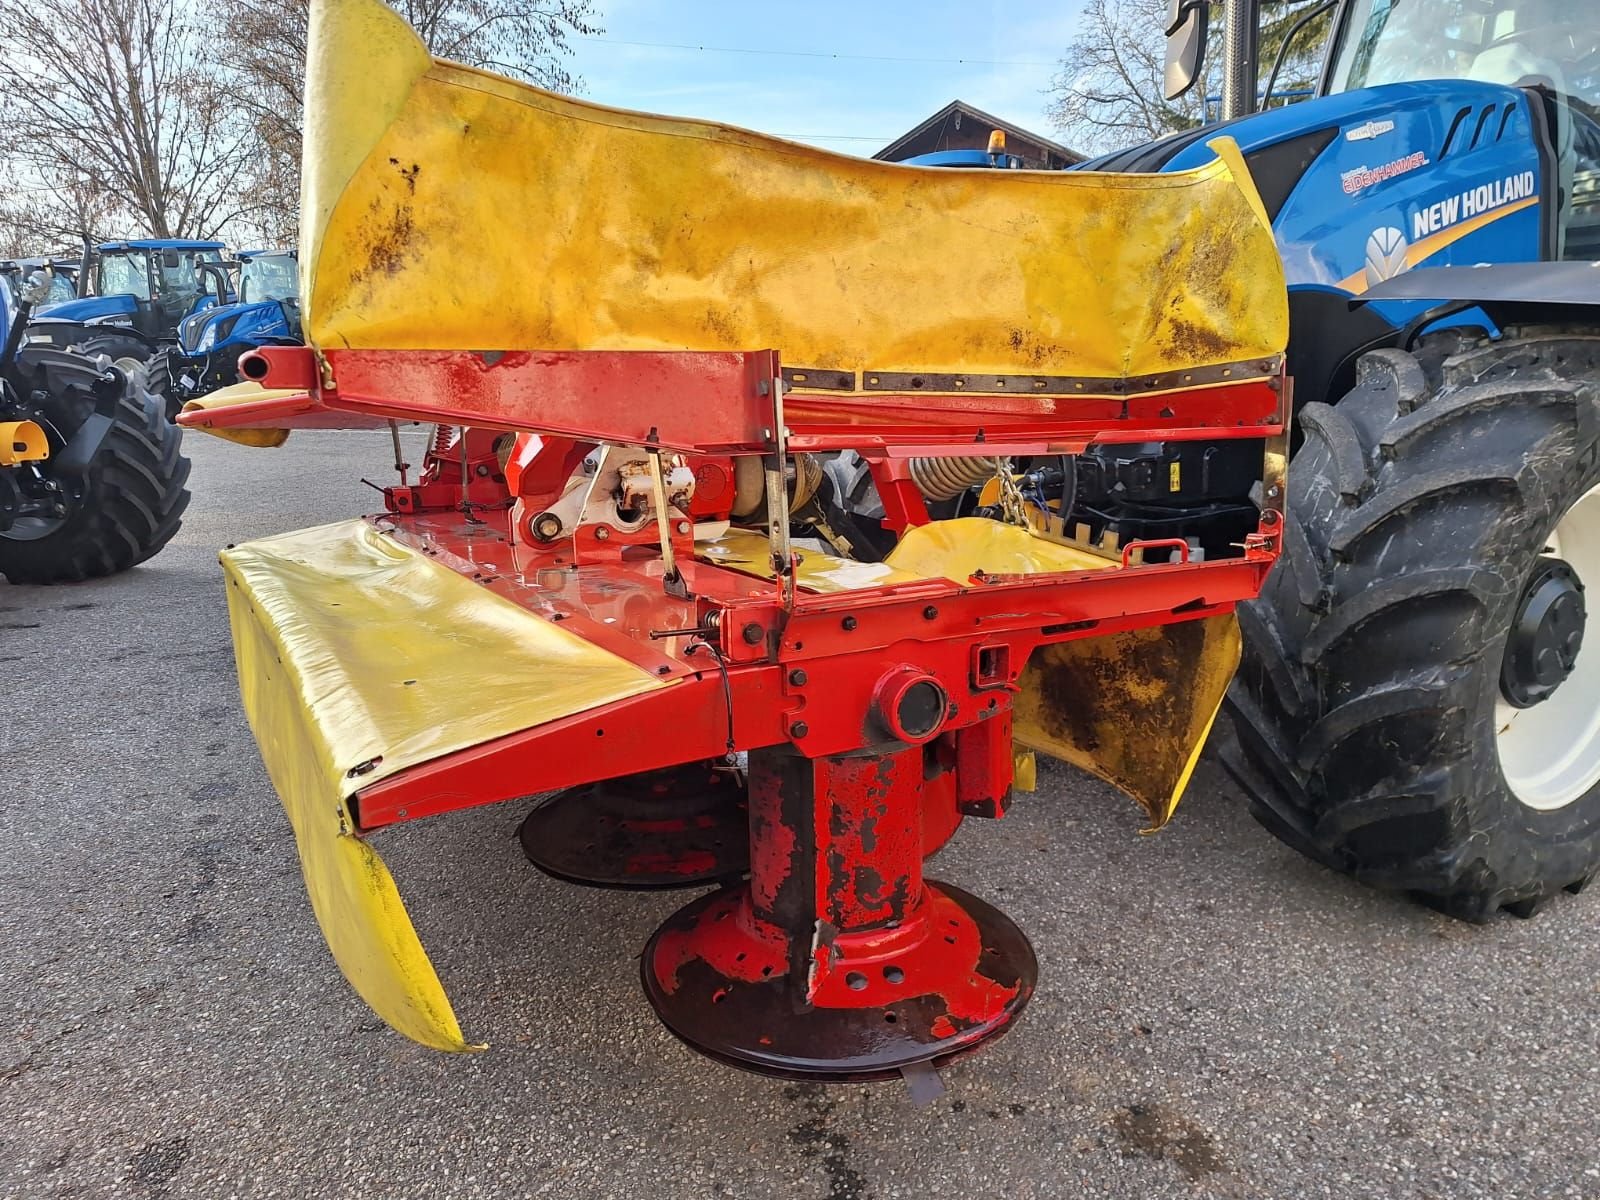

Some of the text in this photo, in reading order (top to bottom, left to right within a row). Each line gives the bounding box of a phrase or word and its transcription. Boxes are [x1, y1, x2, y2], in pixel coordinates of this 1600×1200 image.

[1343, 151, 1425, 193] EIDENHAMMER
[1413, 171, 1534, 239] NEW HOLLAND
